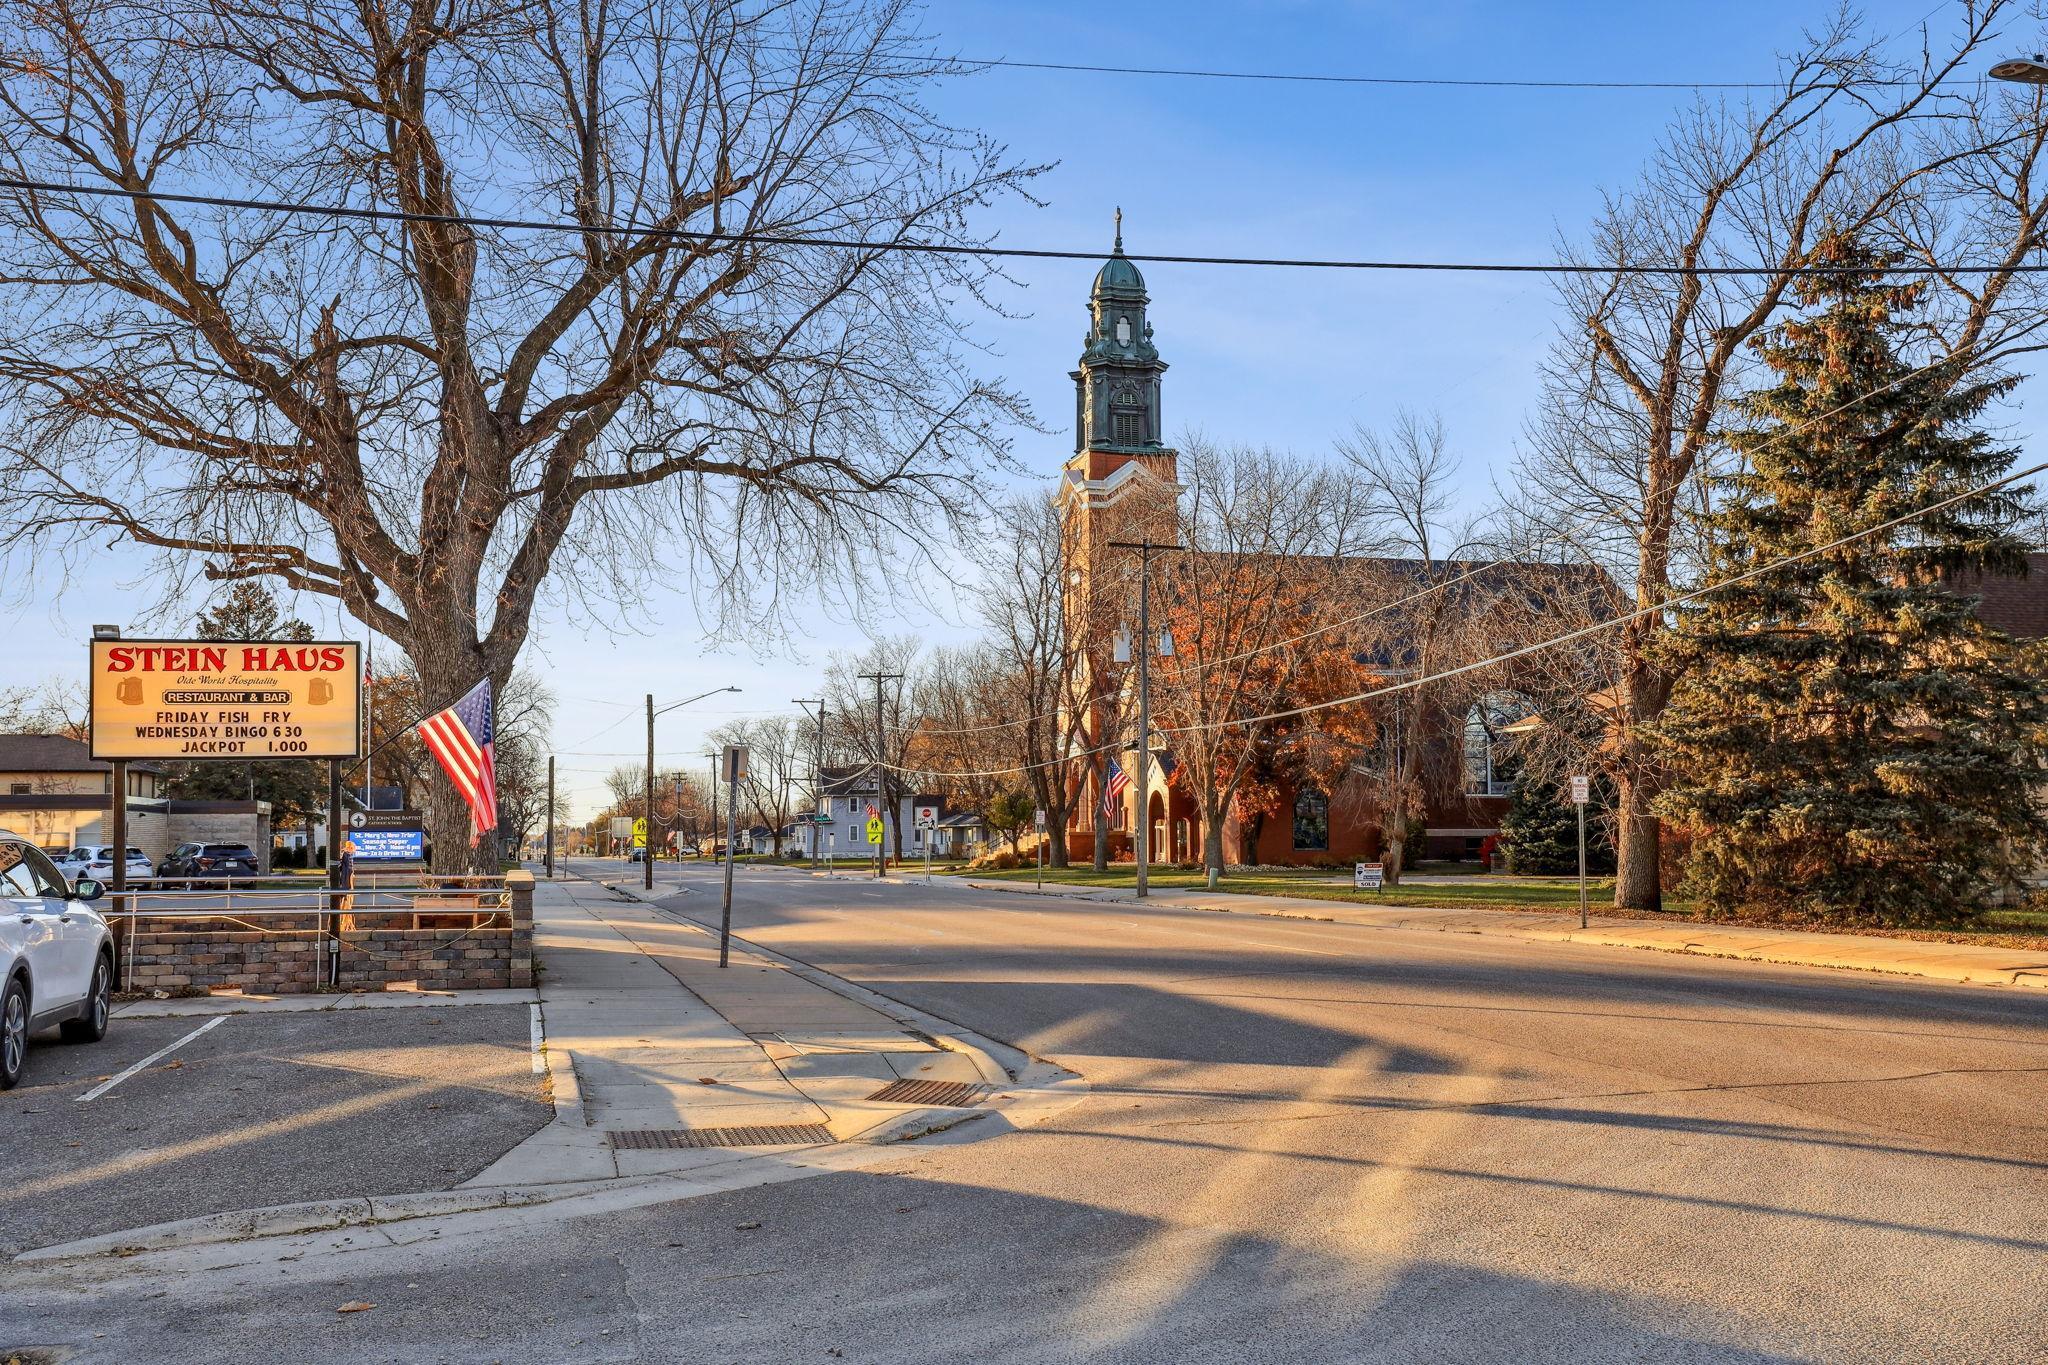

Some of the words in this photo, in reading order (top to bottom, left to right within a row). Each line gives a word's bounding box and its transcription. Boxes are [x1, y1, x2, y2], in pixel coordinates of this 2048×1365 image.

[107, 647, 227, 673] STEIN
[242, 647, 345, 672] HAUS
[176, 675, 197, 685] Olde
[198, 675, 226, 685] World
[229, 675, 279, 686] Hospitality
[168, 692, 245, 703] RESTAURANT
[249, 692, 258, 703] &
[263, 692, 287, 703] BAR
[156, 711, 209, 723] FRIDAY
[218, 711, 249, 723] FISH
[263, 711, 291, 723] FRY
[136, 726, 219, 738] WEDNESDAY
[225, 726, 268, 738] BINGO
[181, 741, 246, 753] JACKPOT
[268, 741, 308, 753] 1.000
